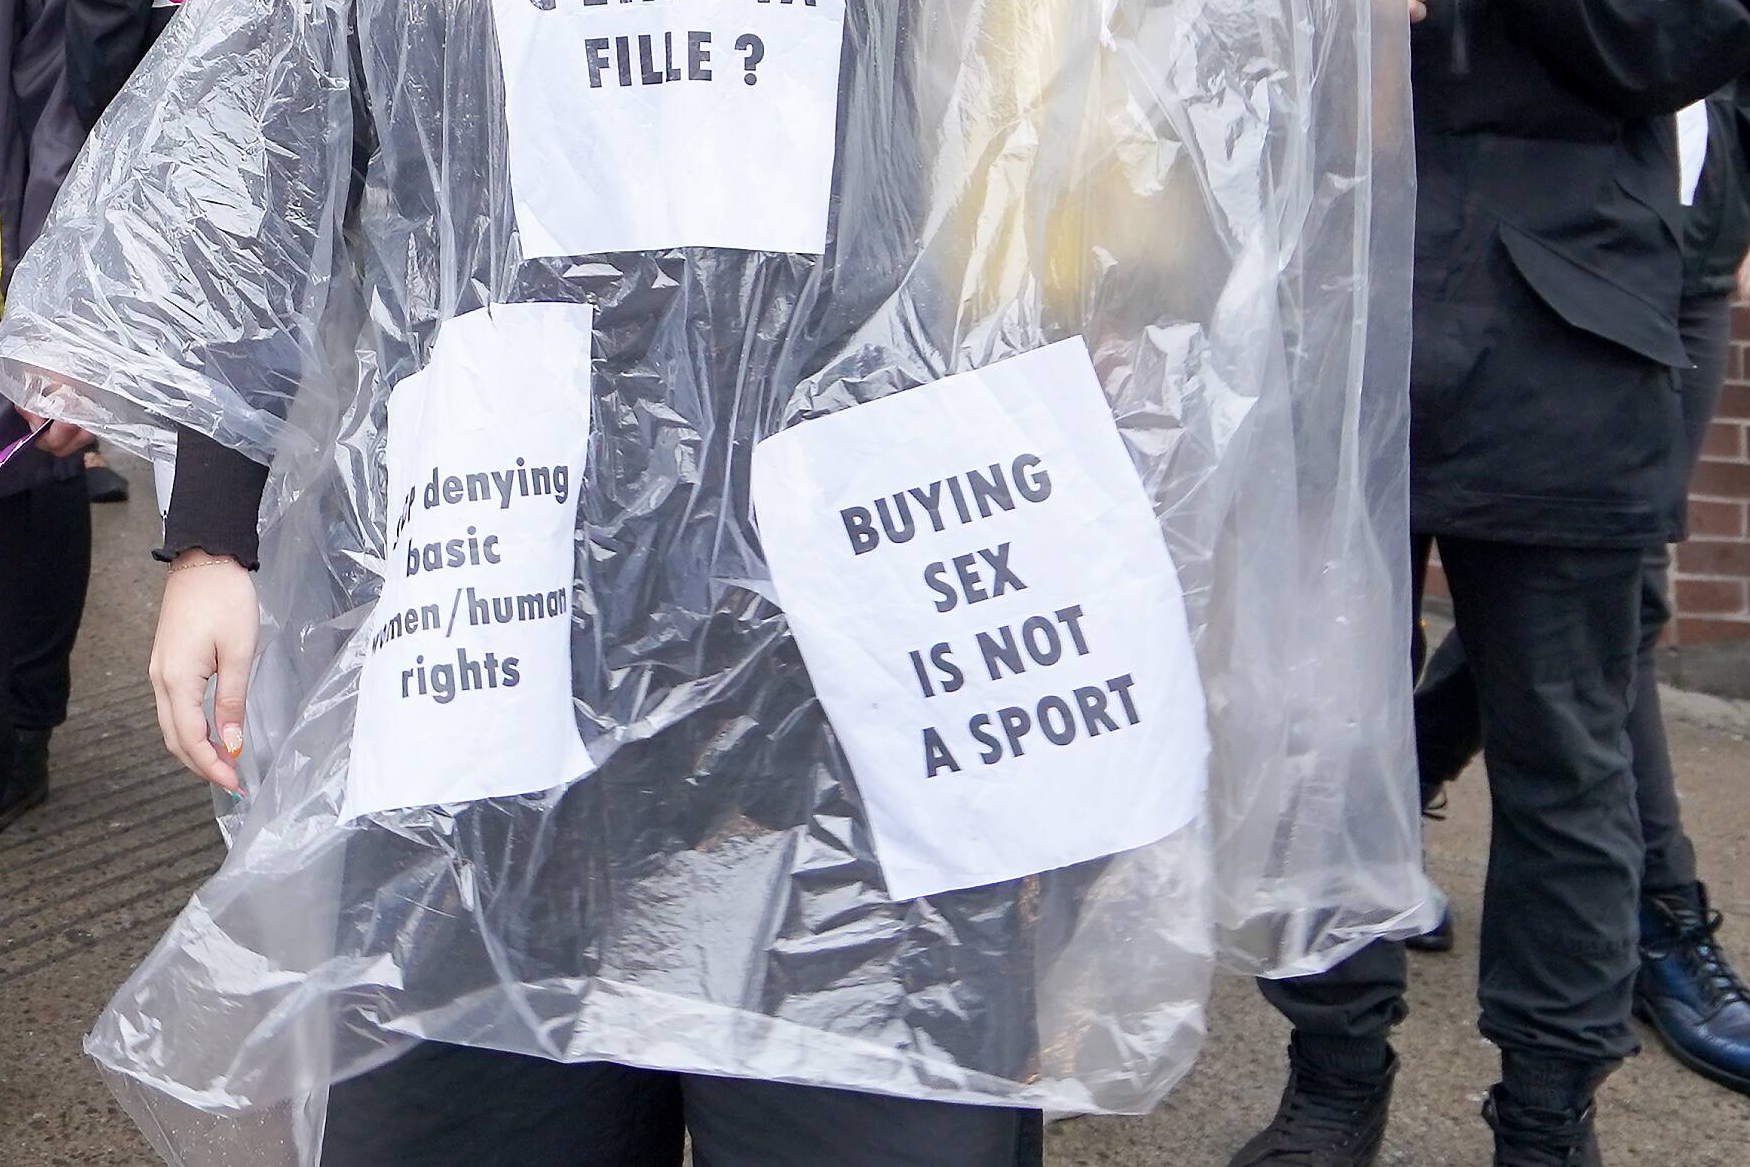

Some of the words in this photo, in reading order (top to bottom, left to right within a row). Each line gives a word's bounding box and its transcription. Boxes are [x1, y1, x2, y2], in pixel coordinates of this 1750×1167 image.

[584, 31, 713, 88] FILLE
[734, 34, 765, 86] ?
[424, 456, 569, 510] denying
[840, 453, 1052, 556] BUYING
[406, 525, 501, 578] basic
[923, 542, 1028, 613] SEX
[400, 647, 521, 704] rights
[908, 642, 965, 698] IS
[975, 604, 1090, 682] NOT
[921, 726, 962, 779] A
[968, 673, 1142, 766] SPORT
